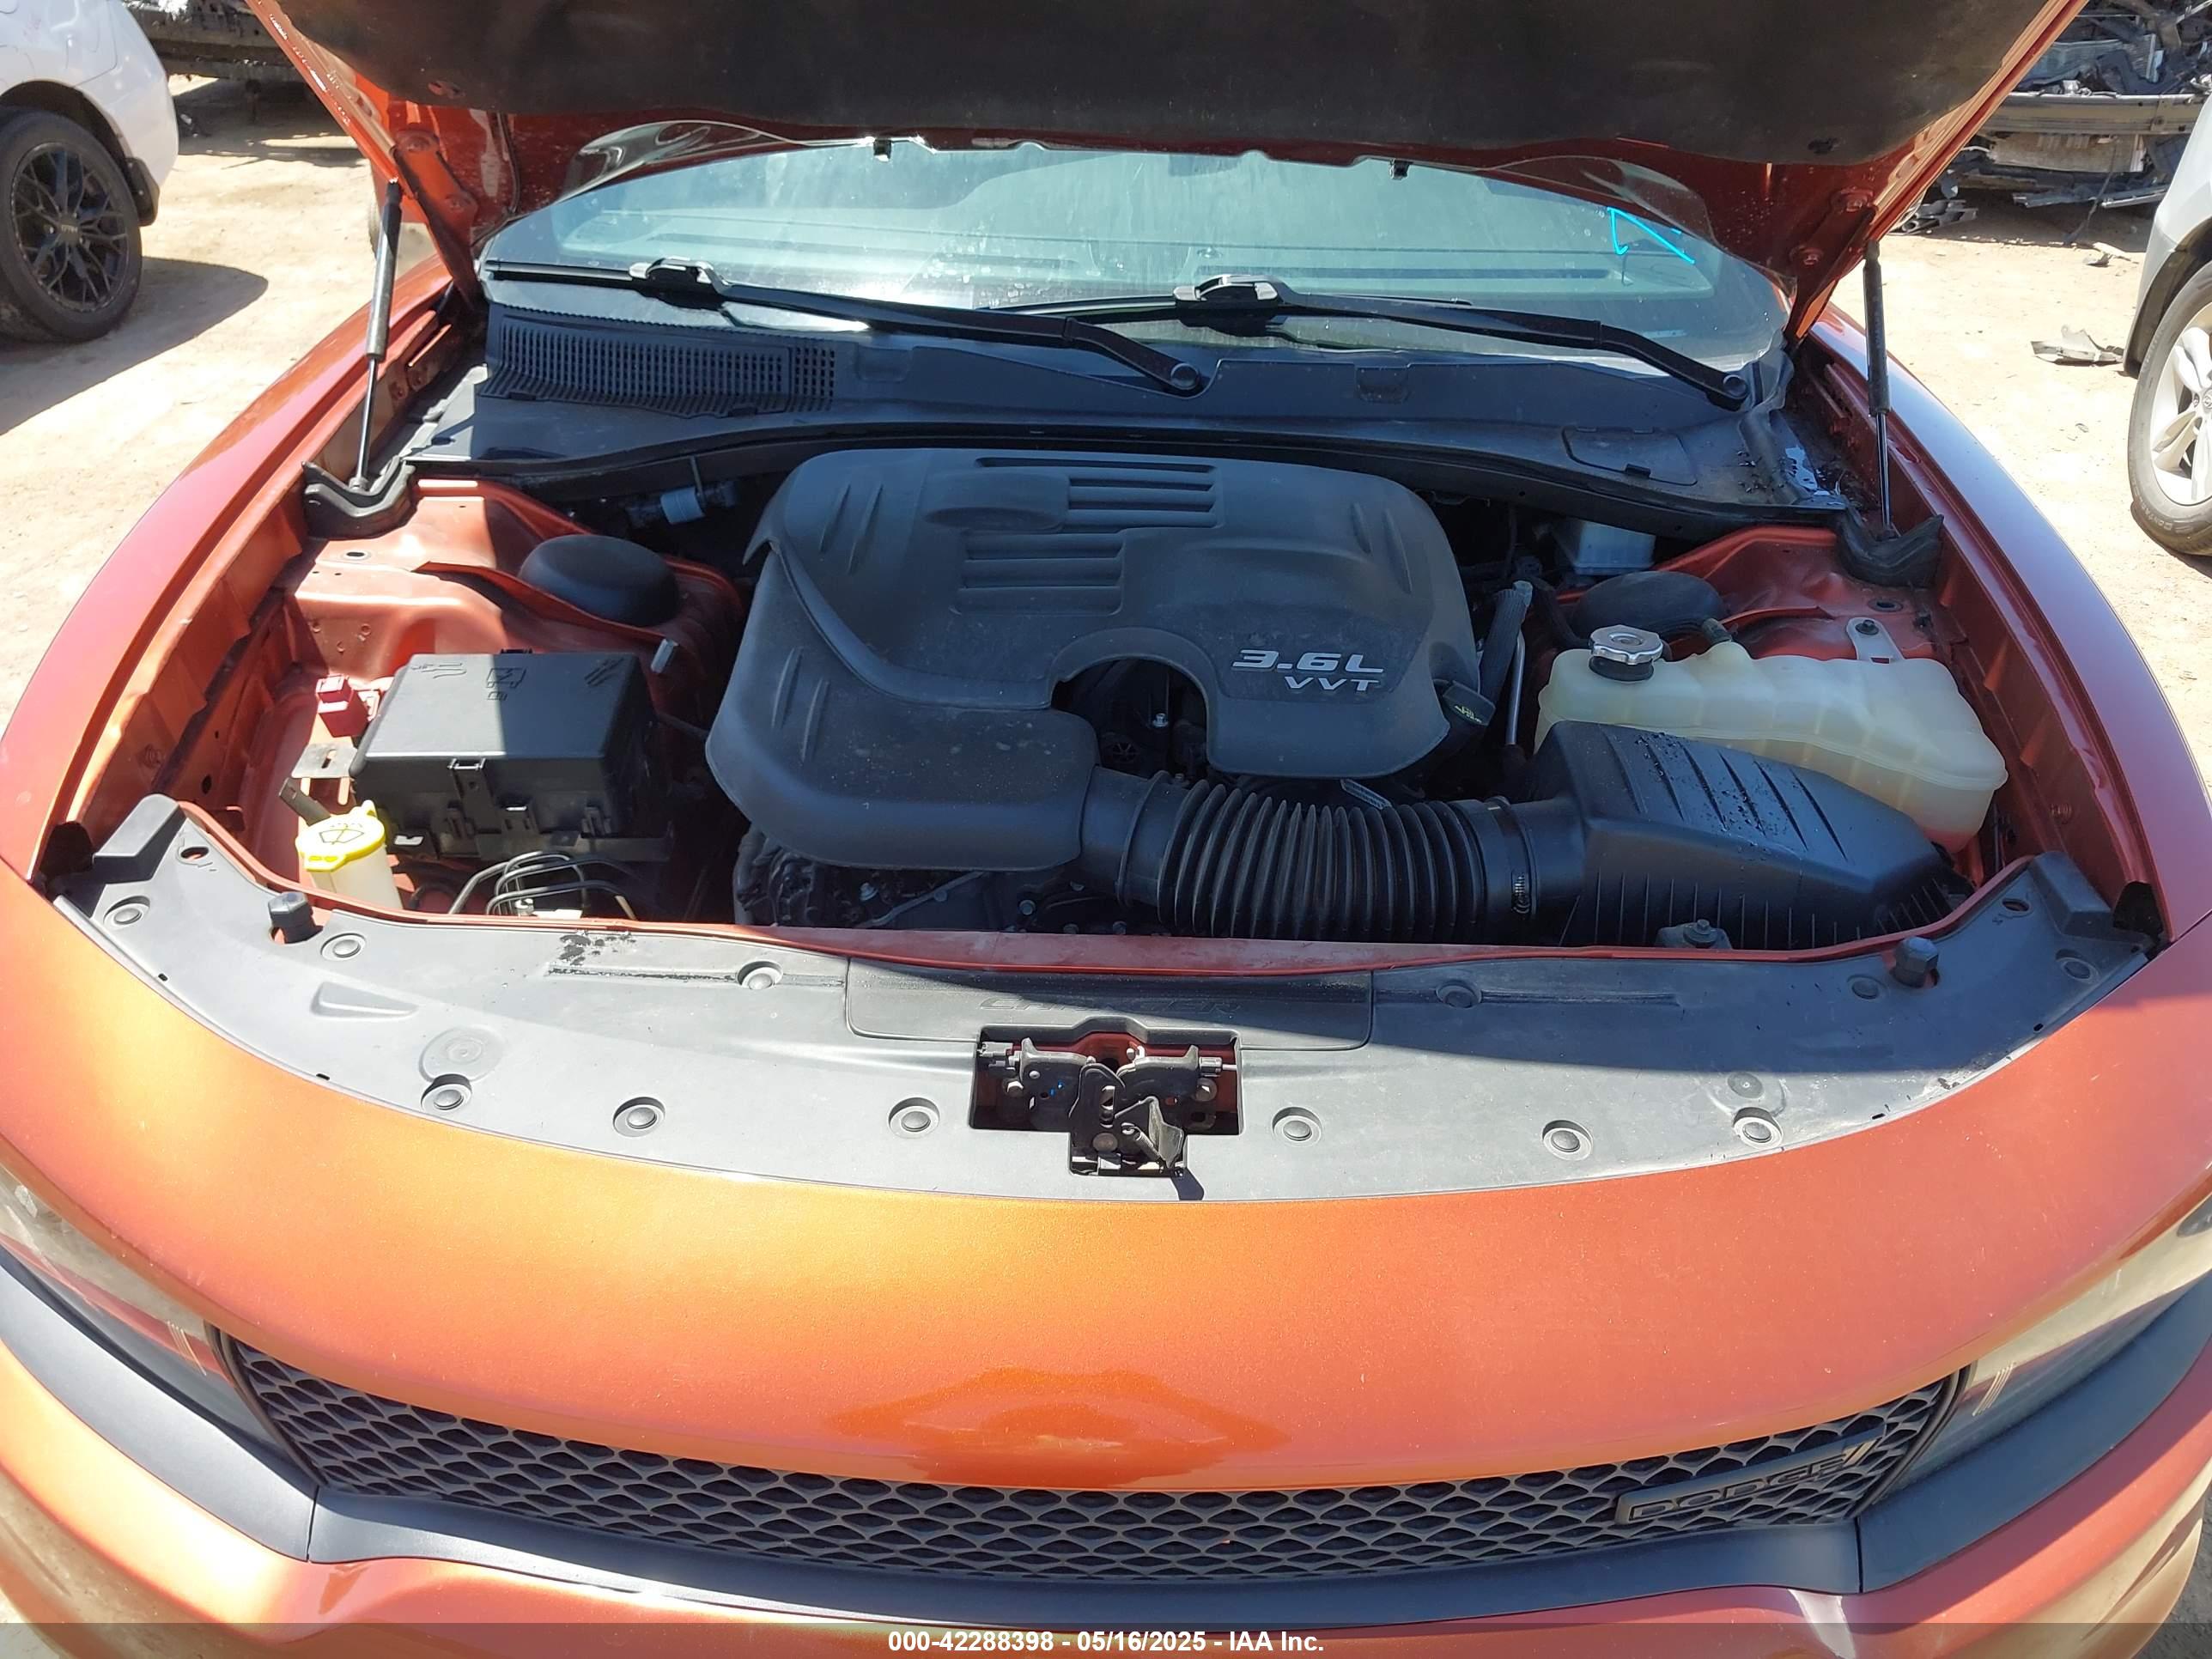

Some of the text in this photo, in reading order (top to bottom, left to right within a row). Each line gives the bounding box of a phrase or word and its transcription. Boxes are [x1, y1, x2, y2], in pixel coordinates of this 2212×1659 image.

[1232, 649, 1384, 673] 3.6L
[1284, 676, 1380, 691] VVT
[1630, 1458, 1845, 1520] DODGE
